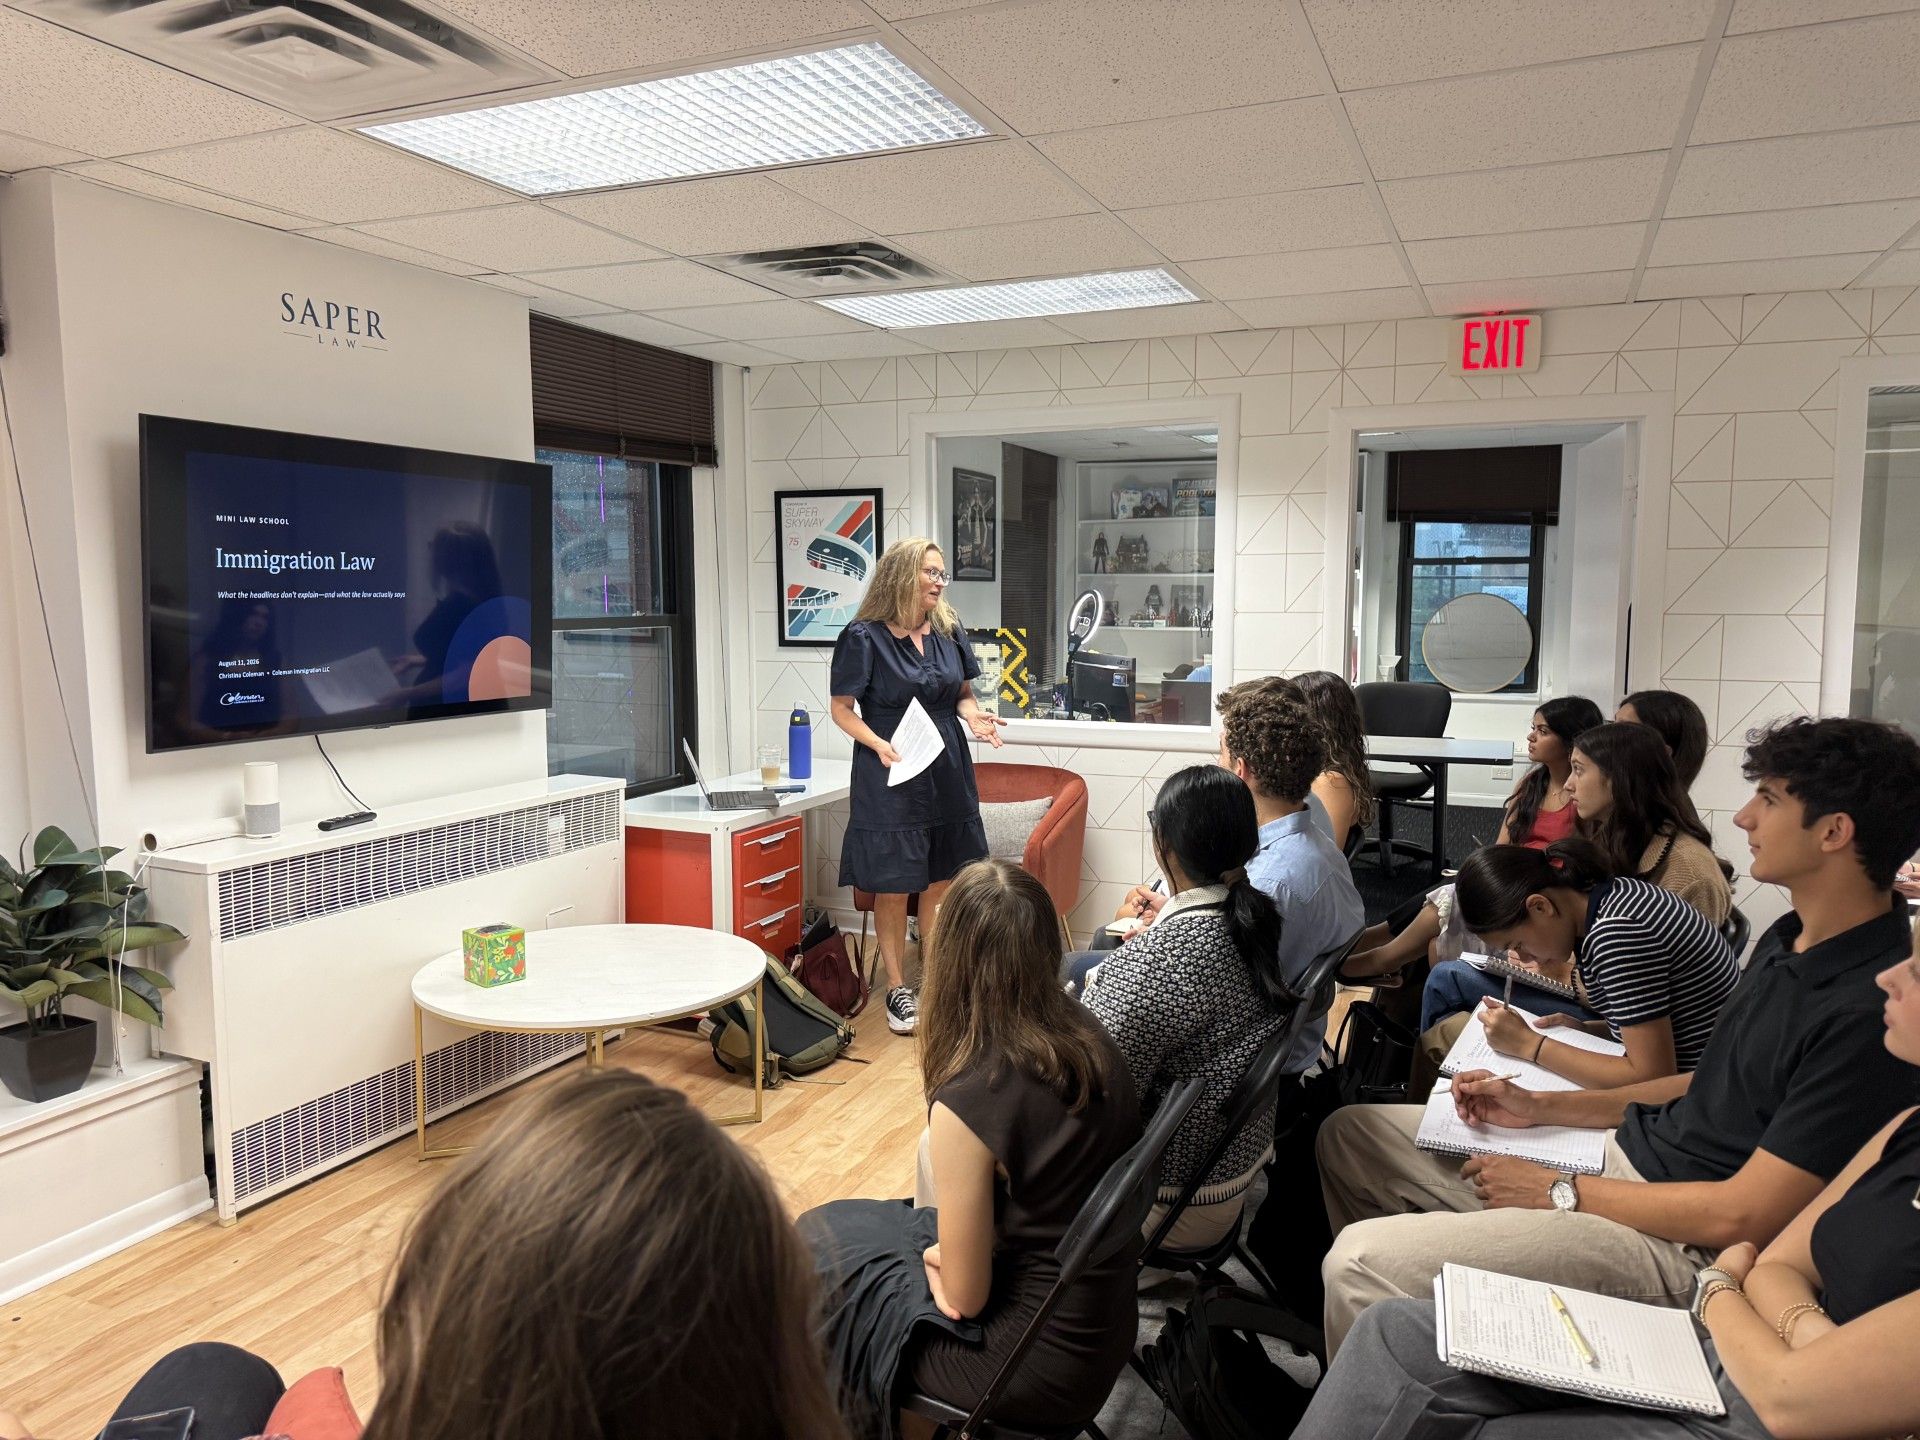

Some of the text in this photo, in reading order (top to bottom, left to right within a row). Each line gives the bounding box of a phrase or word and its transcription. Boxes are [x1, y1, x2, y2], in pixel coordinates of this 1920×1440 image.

[281, 292, 387, 340] SAPER
[318, 333, 356, 349] LAW
[1461, 319, 1531, 370] EXIT
[785, 507, 818, 517] SUPER
[216, 515, 290, 526] MINI LAW SCHOOL
[784, 518, 824, 528] SKYWAY
[789, 537, 800, 546] 75
[216, 547, 376, 575] Immigration Law
[217, 591, 237, 599] What
[237, 591, 249, 599] the
[249, 591, 280, 599] headlines
[280, 591, 297, 599] don't
[336, 591, 351, 599] what
[351, 591, 361, 599] the
[361, 591, 373, 599] law
[372, 591, 393, 599] actually
[393, 591, 406, 599] says
[218, 660, 237, 668] August
[246, 658, 260, 666] 2026
[218, 665, 331, 680] Christina Coleman Coleman Immigration LLC
